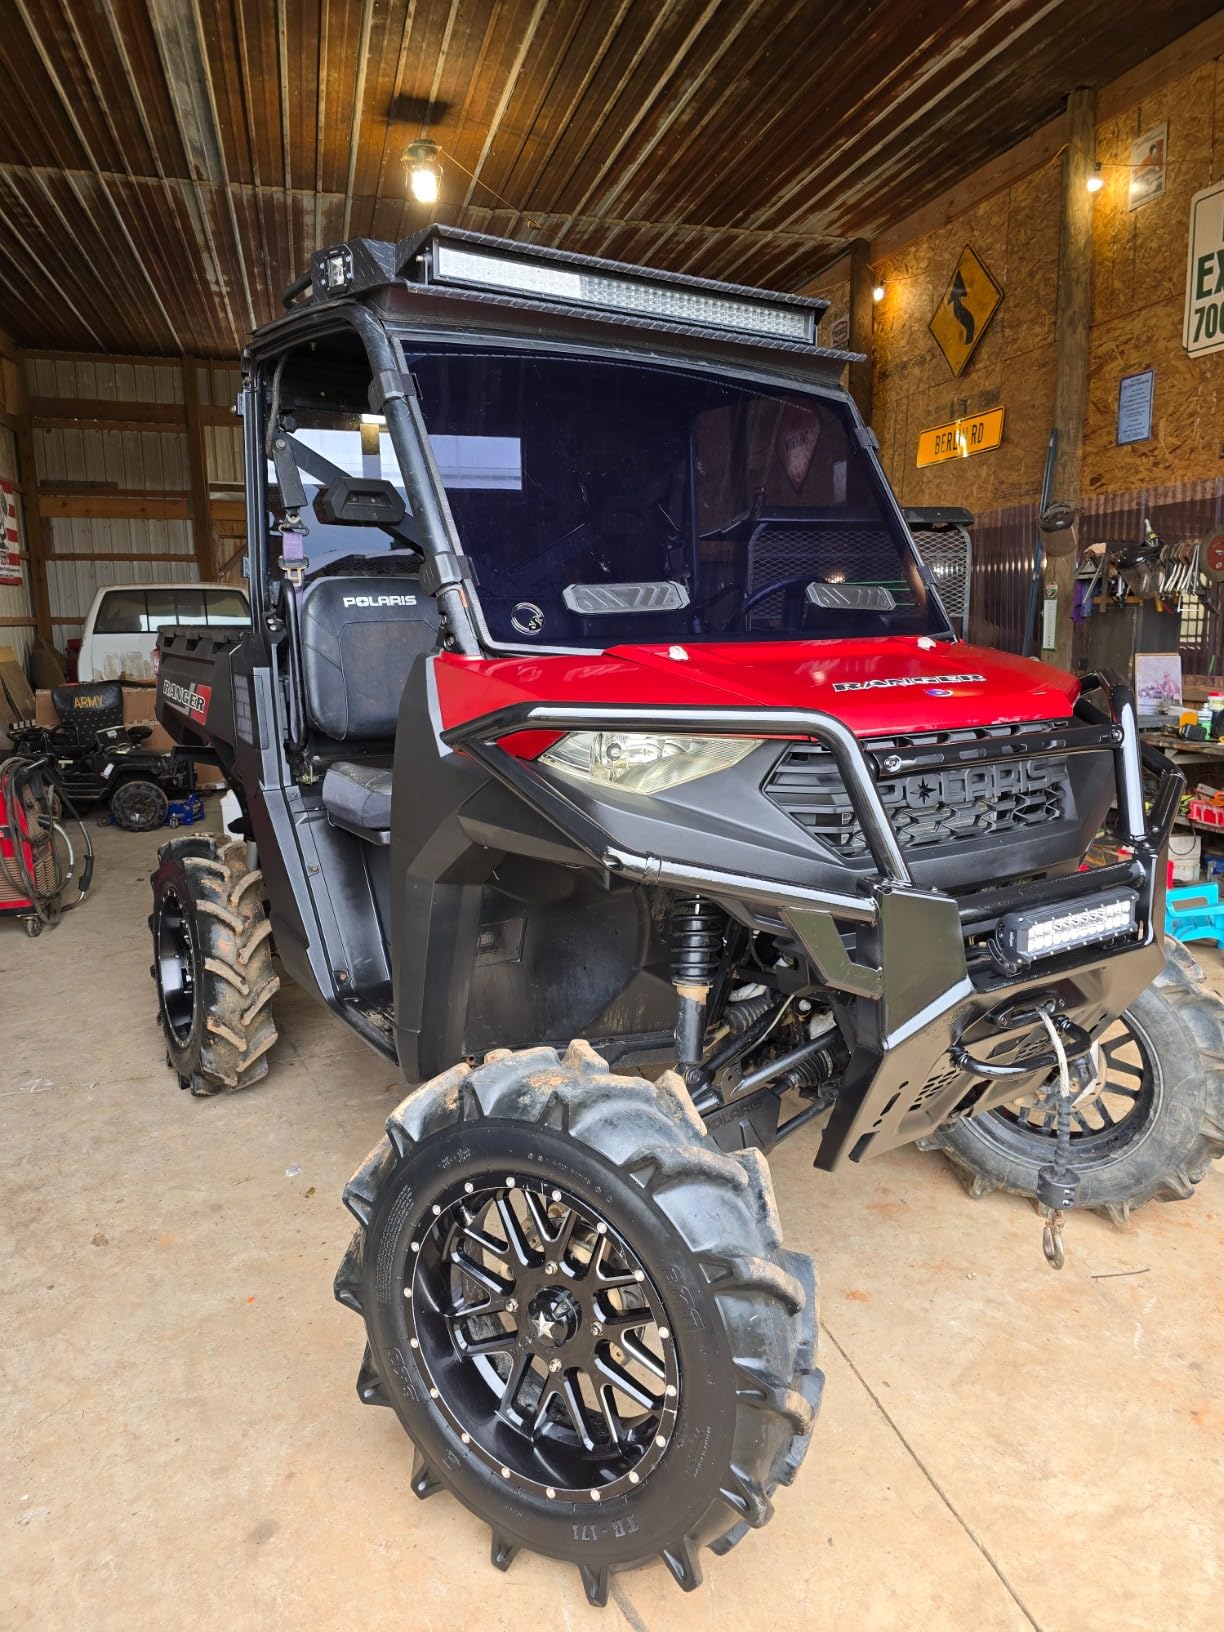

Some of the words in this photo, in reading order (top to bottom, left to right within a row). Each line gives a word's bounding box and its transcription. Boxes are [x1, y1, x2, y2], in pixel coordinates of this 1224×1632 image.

[971, 422, 984, 446] RD
[342, 594, 417, 608] POLARIS
[832, 674, 987, 692] RANGER
[74, 695, 103, 709] ARMY
[162, 679, 206, 714] RANGER
